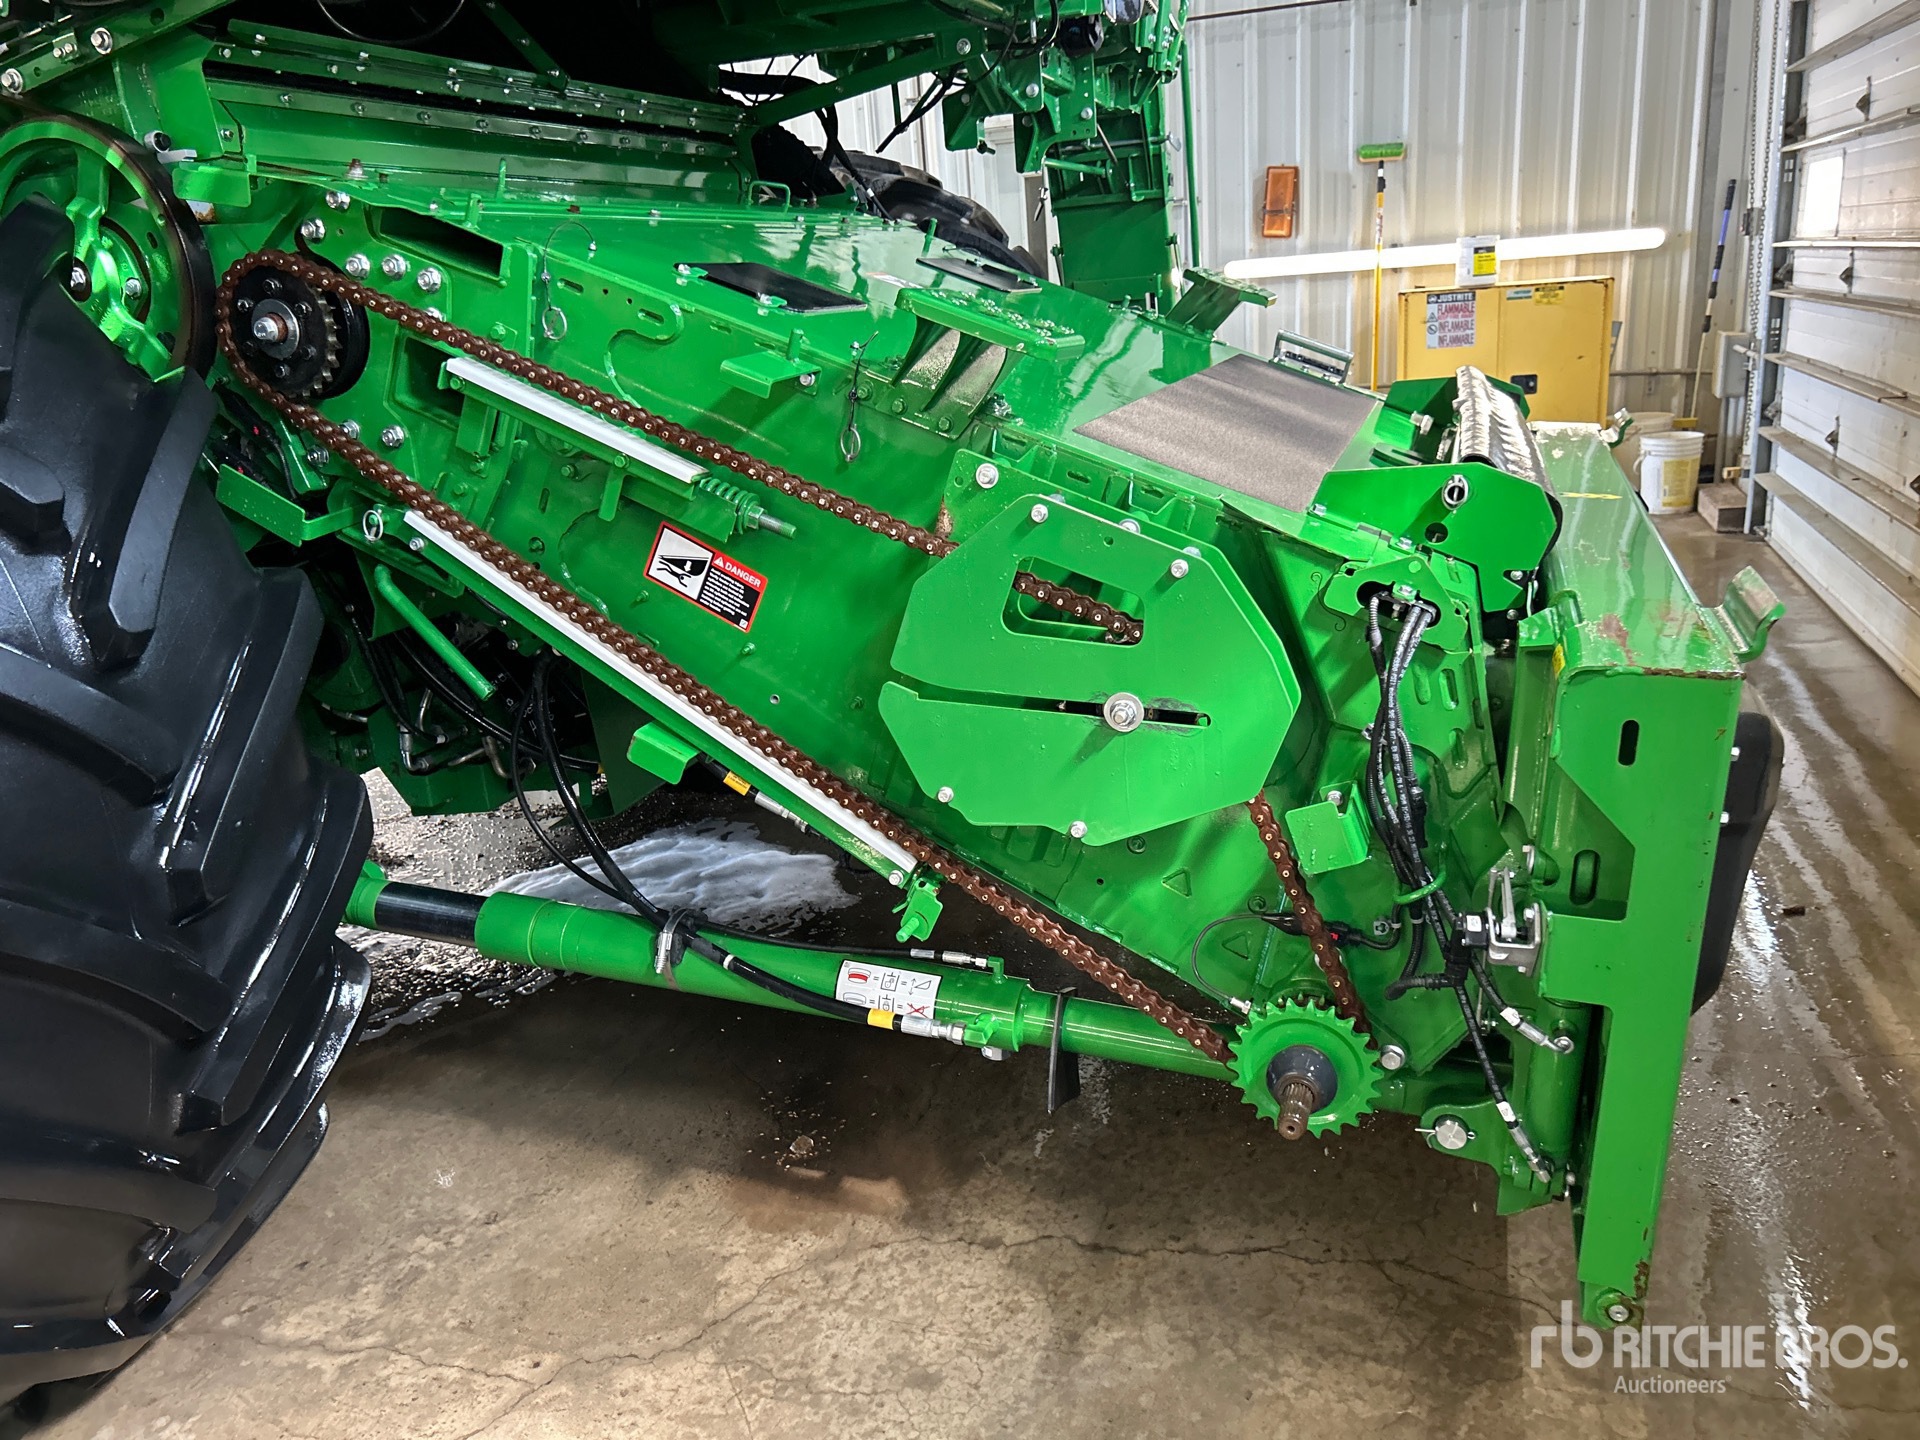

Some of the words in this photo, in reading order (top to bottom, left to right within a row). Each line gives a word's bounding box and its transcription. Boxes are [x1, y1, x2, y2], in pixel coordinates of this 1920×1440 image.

[1437, 293, 1473, 303] JUSTRITE
[1437, 302, 1475, 315] FLAMMABLE
[1439, 319, 1475, 333] INFLAMABLE
[725, 562, 761, 588] DANGER
